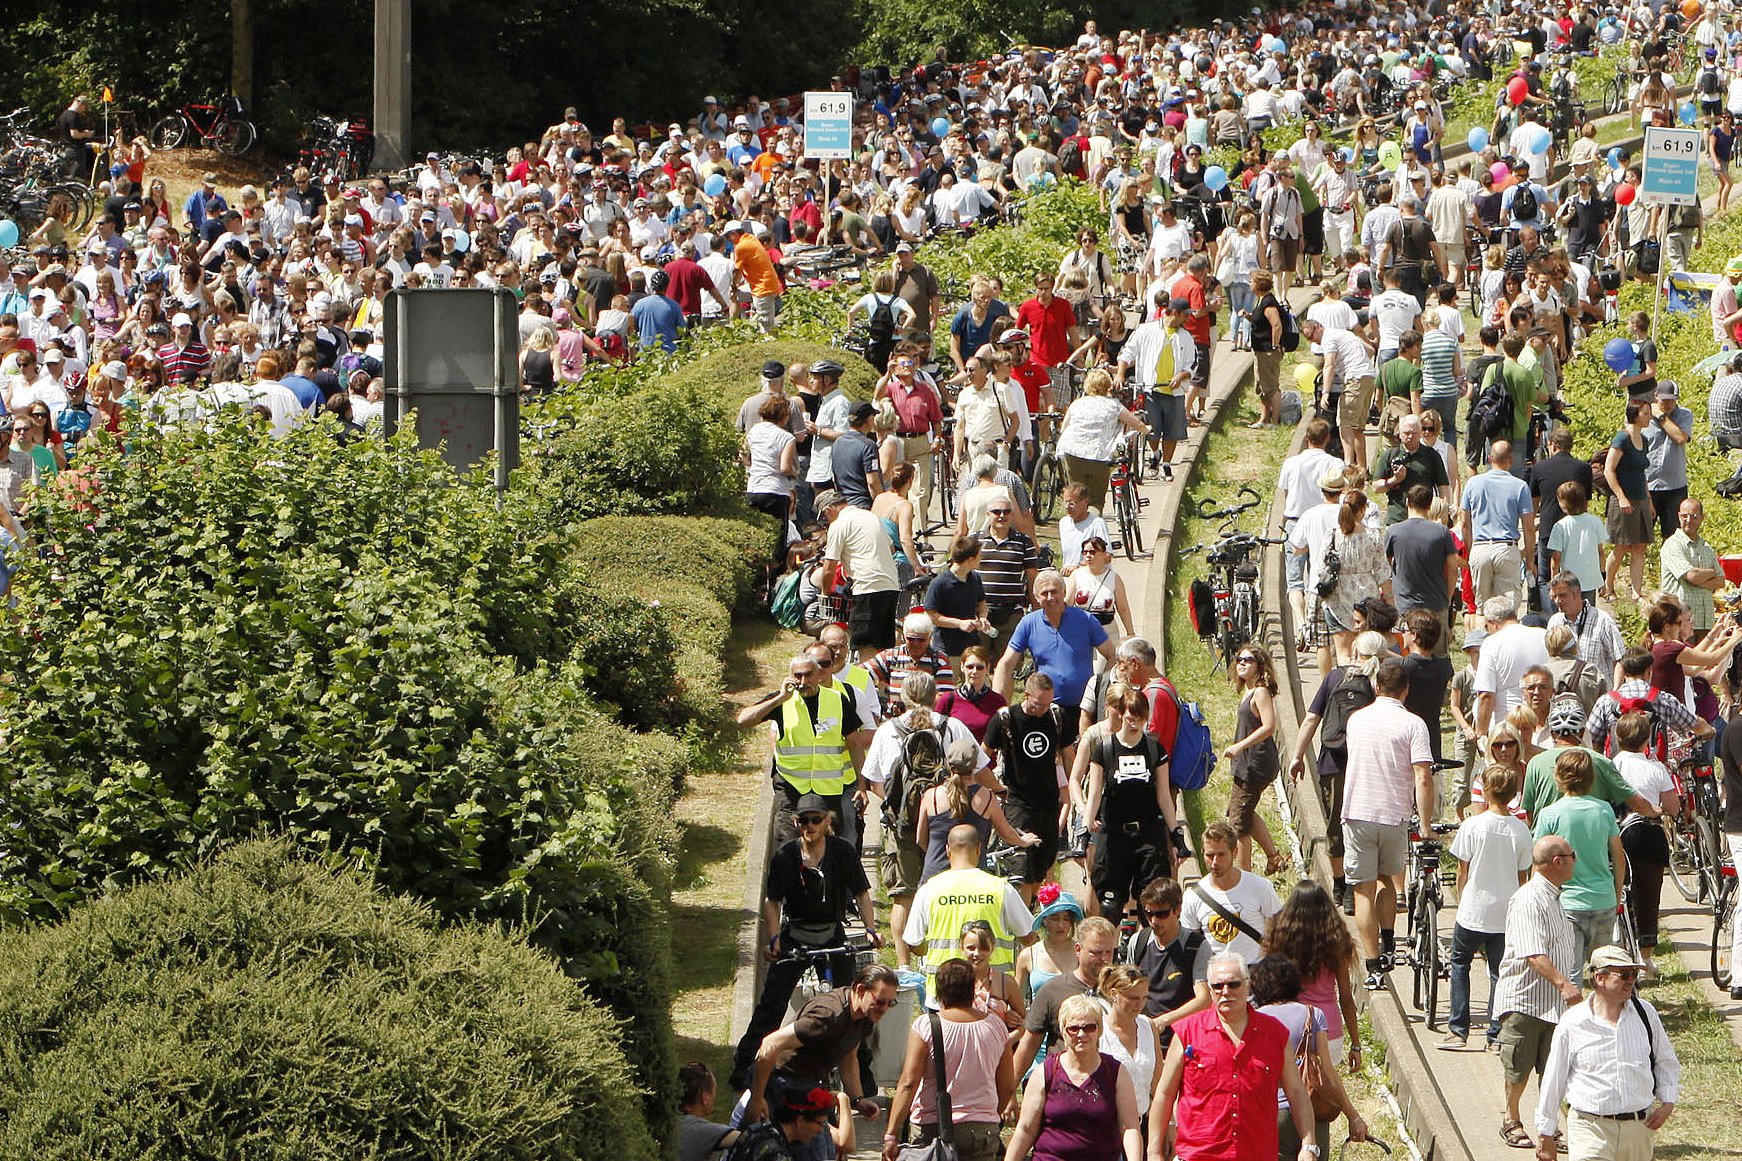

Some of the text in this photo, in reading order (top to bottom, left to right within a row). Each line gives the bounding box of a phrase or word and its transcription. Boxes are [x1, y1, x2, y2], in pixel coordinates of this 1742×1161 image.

[820, 102, 846, 115] 61,9
[1663, 139, 1694, 154] 61,9
[938, 894, 995, 906] ORDNER
